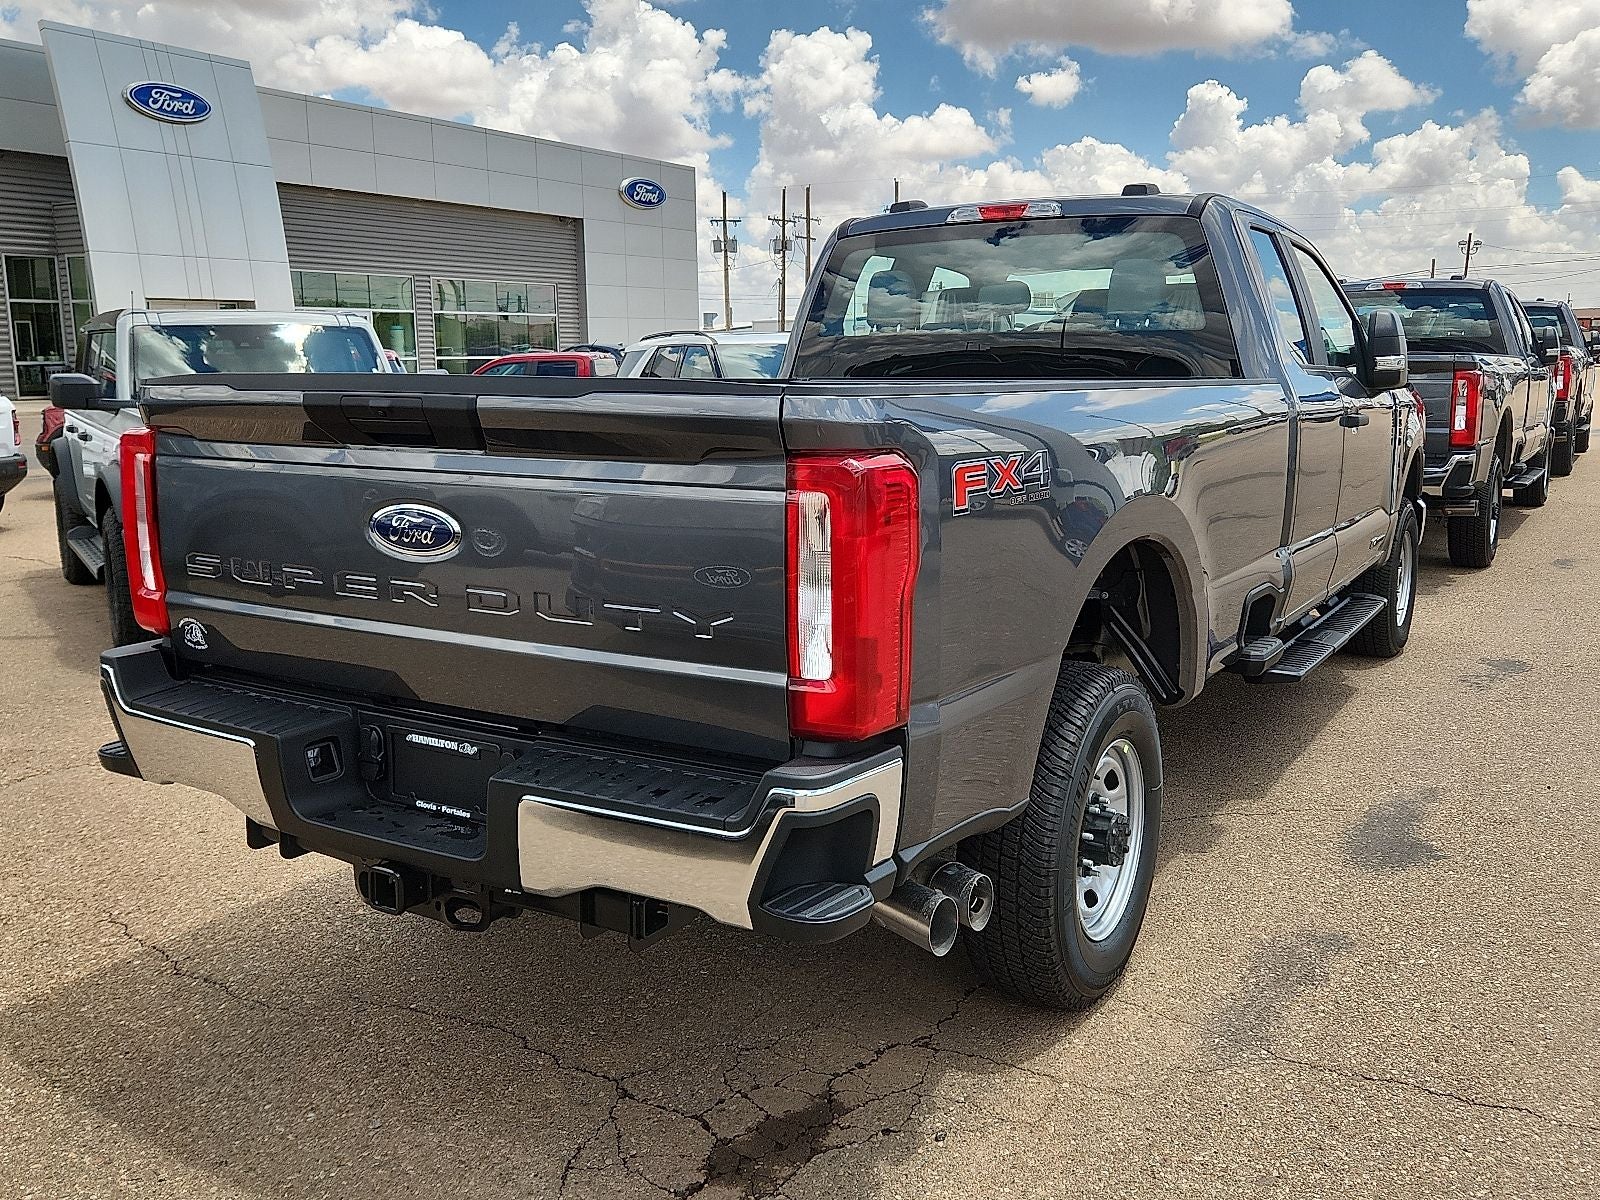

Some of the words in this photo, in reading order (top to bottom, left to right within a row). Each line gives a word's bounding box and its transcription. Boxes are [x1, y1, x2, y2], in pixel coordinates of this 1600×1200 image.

[148, 88, 196, 115] Ford
[633, 183, 660, 203] Ford
[951, 449, 1051, 517] FX4
[1010, 495, 1027, 506] OFF
[1028, 490, 1051, 502] ROAD
[389, 514, 436, 545] Ford
[185, 551, 439, 608] SUPER
[465, 585, 735, 639] DUTY
[411, 733, 458, 751] HAMILTON
[415, 800, 437, 811] Clovis
[441, 805, 471, 818] Portales
